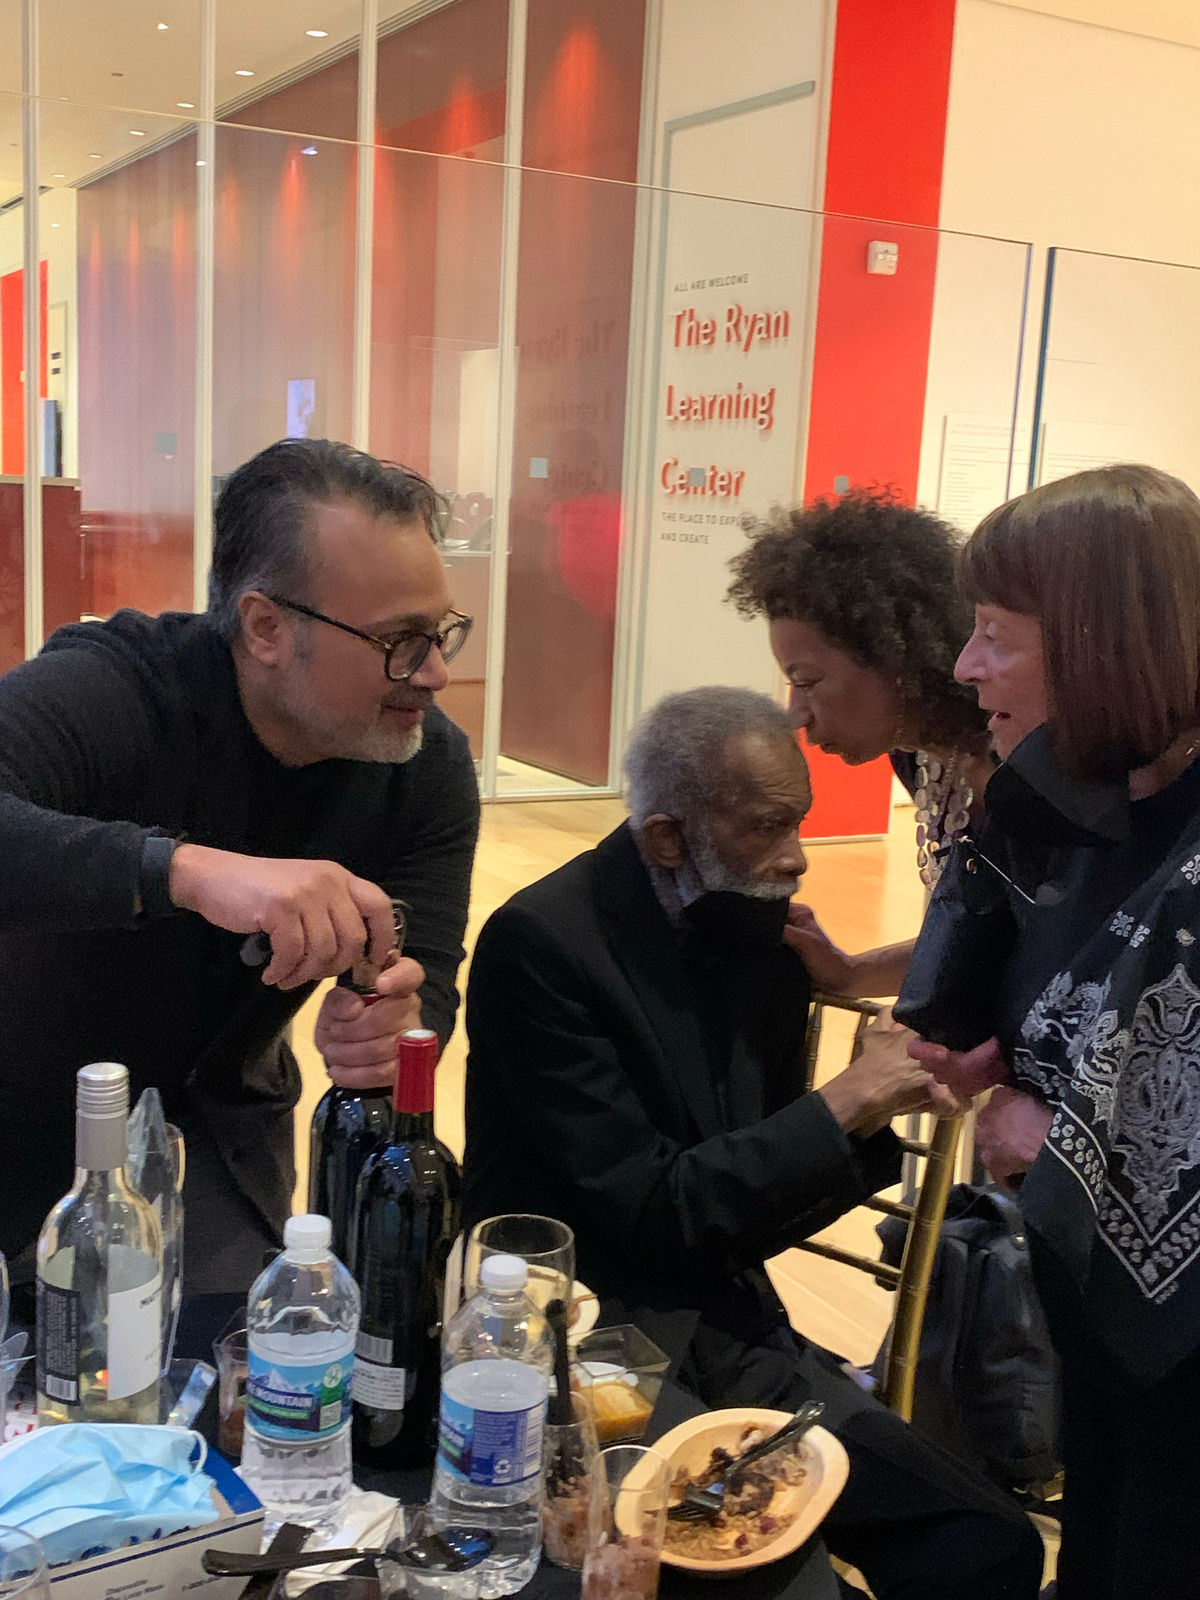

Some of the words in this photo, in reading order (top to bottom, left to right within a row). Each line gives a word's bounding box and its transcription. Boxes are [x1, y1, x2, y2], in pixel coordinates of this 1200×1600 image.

[674, 281, 689, 292] ALL
[691, 279, 706, 290] ARE
[708, 273, 749, 287] WELCOME
[672, 307, 717, 348] The
[725, 303, 790, 352] Ryan
[665, 382, 776, 431] Learning
[662, 511, 676, 522] THE
[679, 513, 704, 524] PLACE
[706, 514, 717, 525] TO
[660, 532, 676, 542] AND
[679, 533, 709, 545] CREATE
